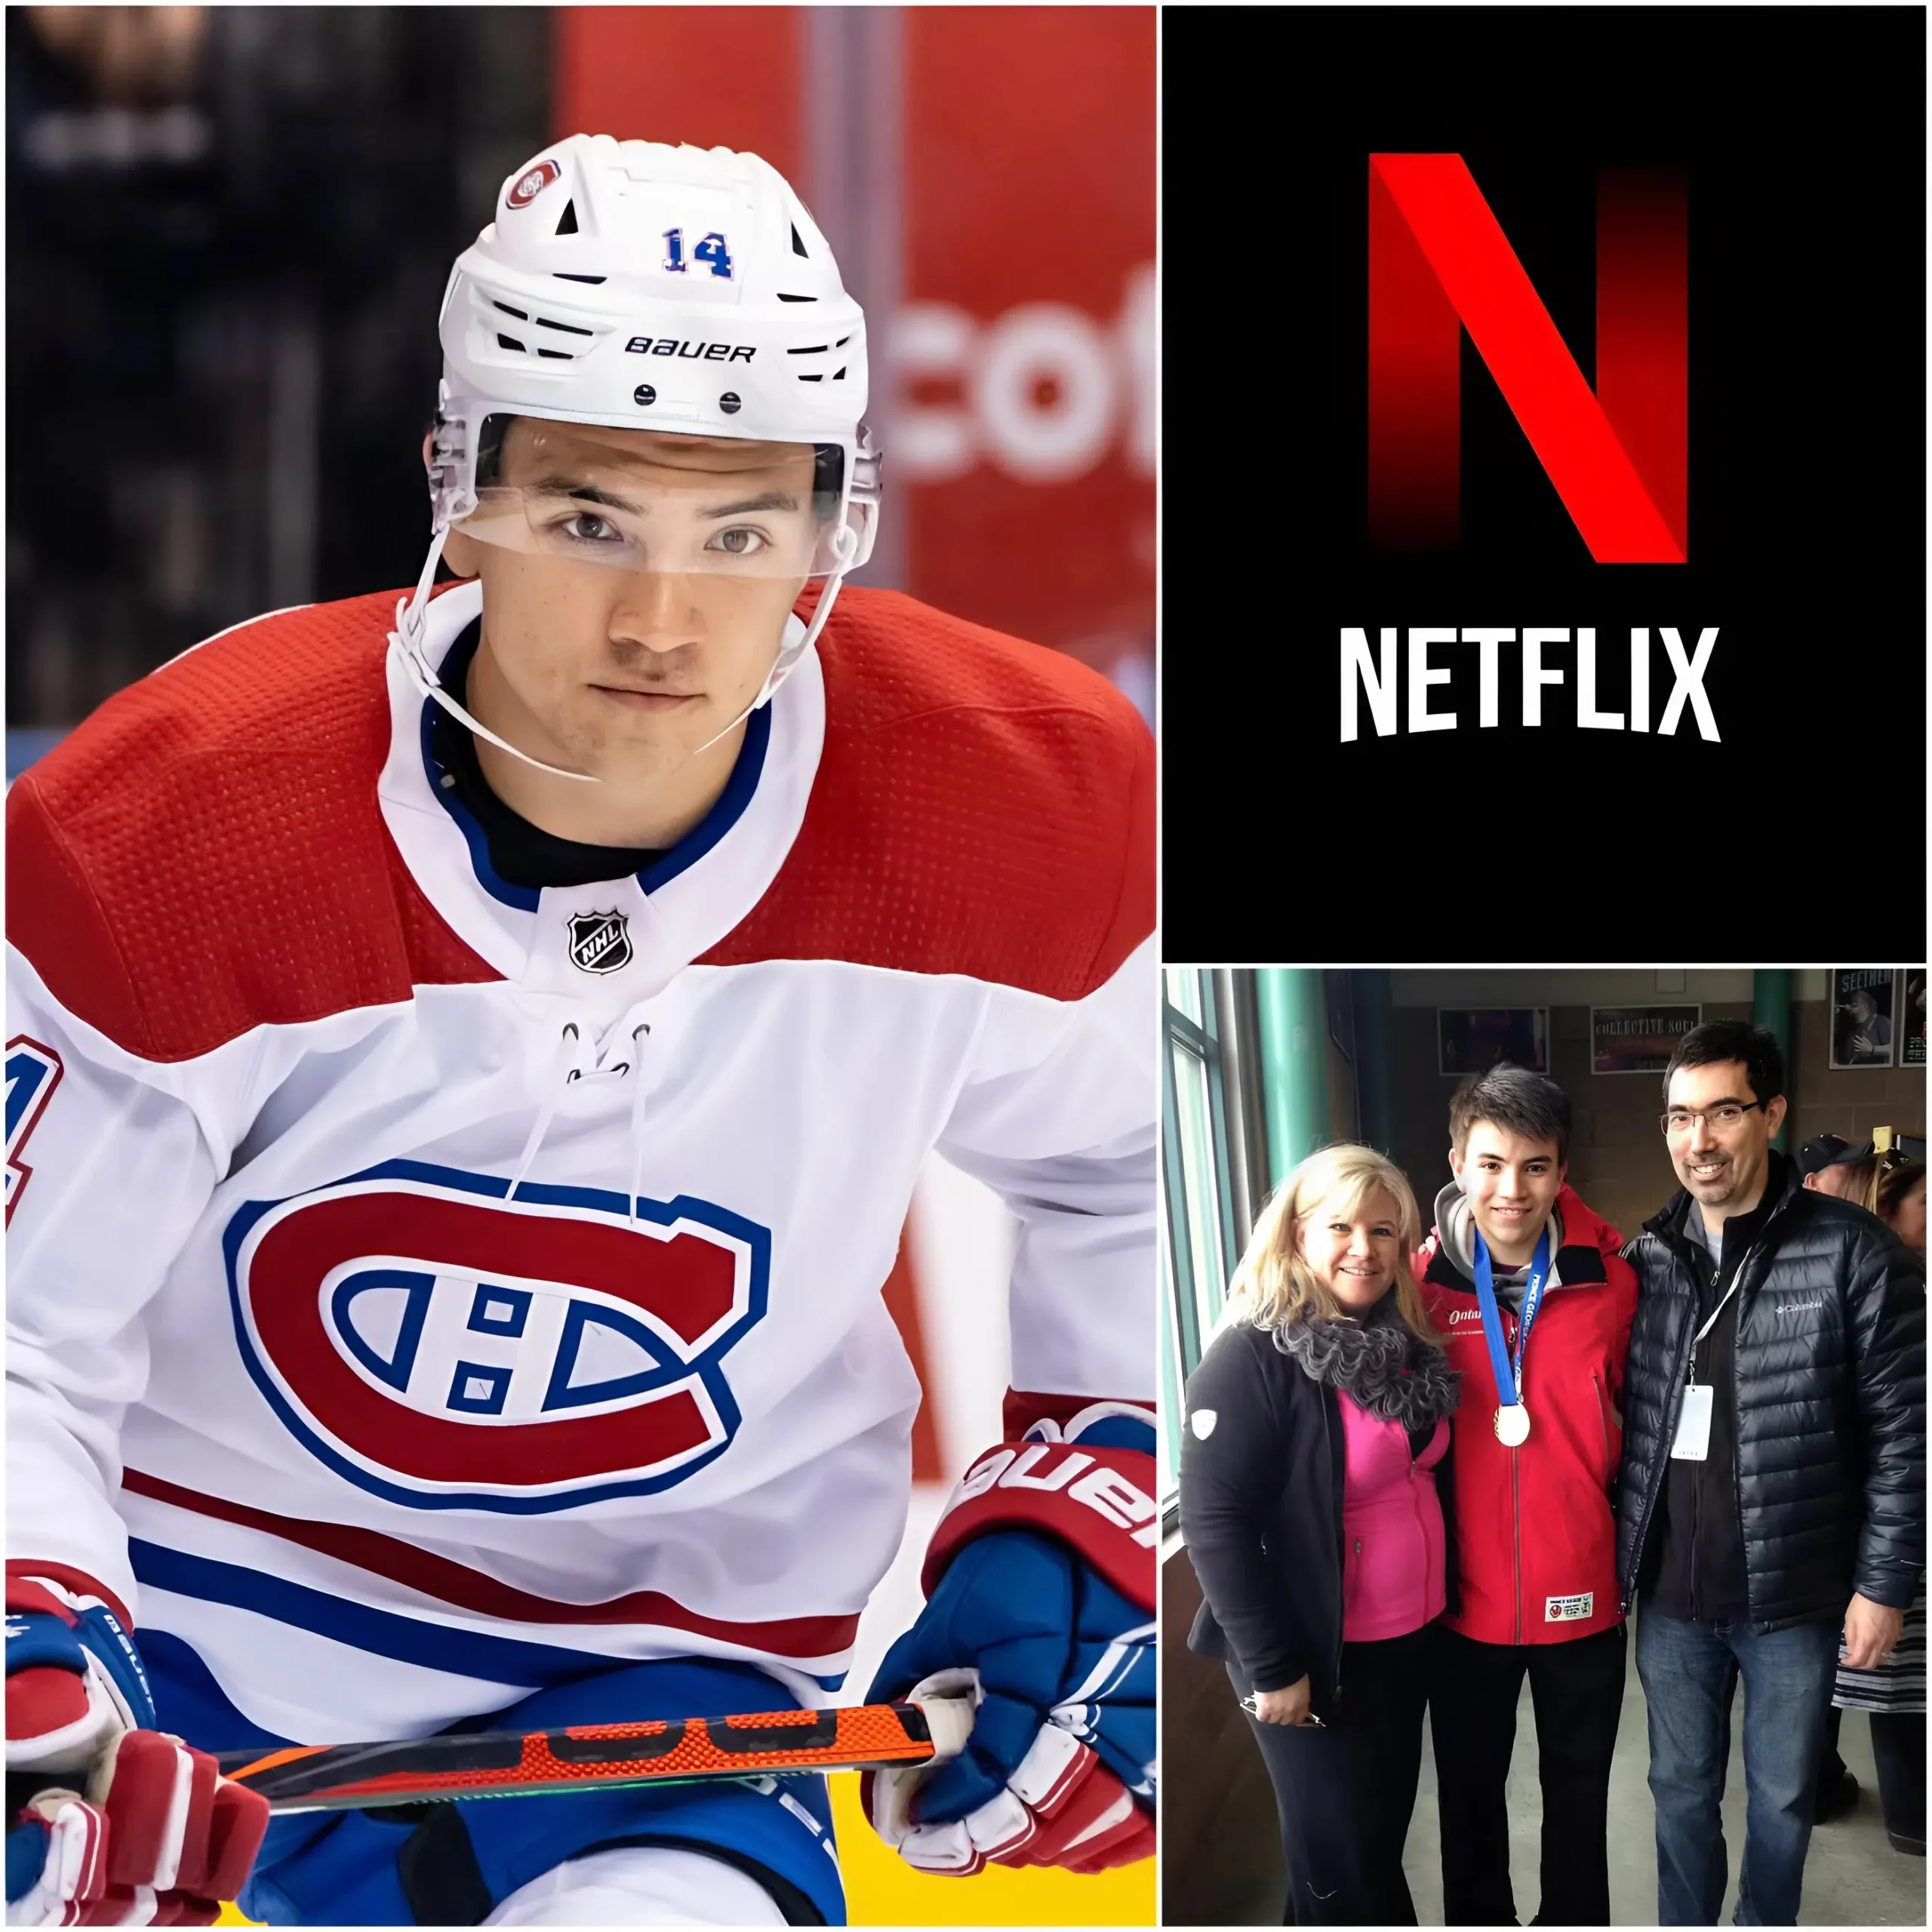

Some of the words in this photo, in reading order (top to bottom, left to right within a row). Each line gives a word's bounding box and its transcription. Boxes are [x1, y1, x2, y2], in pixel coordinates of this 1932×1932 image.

[662, 228, 735, 281] 14
[1340, 628, 1721, 743] NETFLIX
[582, 924, 619, 964] NHL
[1595, 1019, 1663, 1035] COLLECTIVE
[942, 1444, 1157, 1549] AUE
